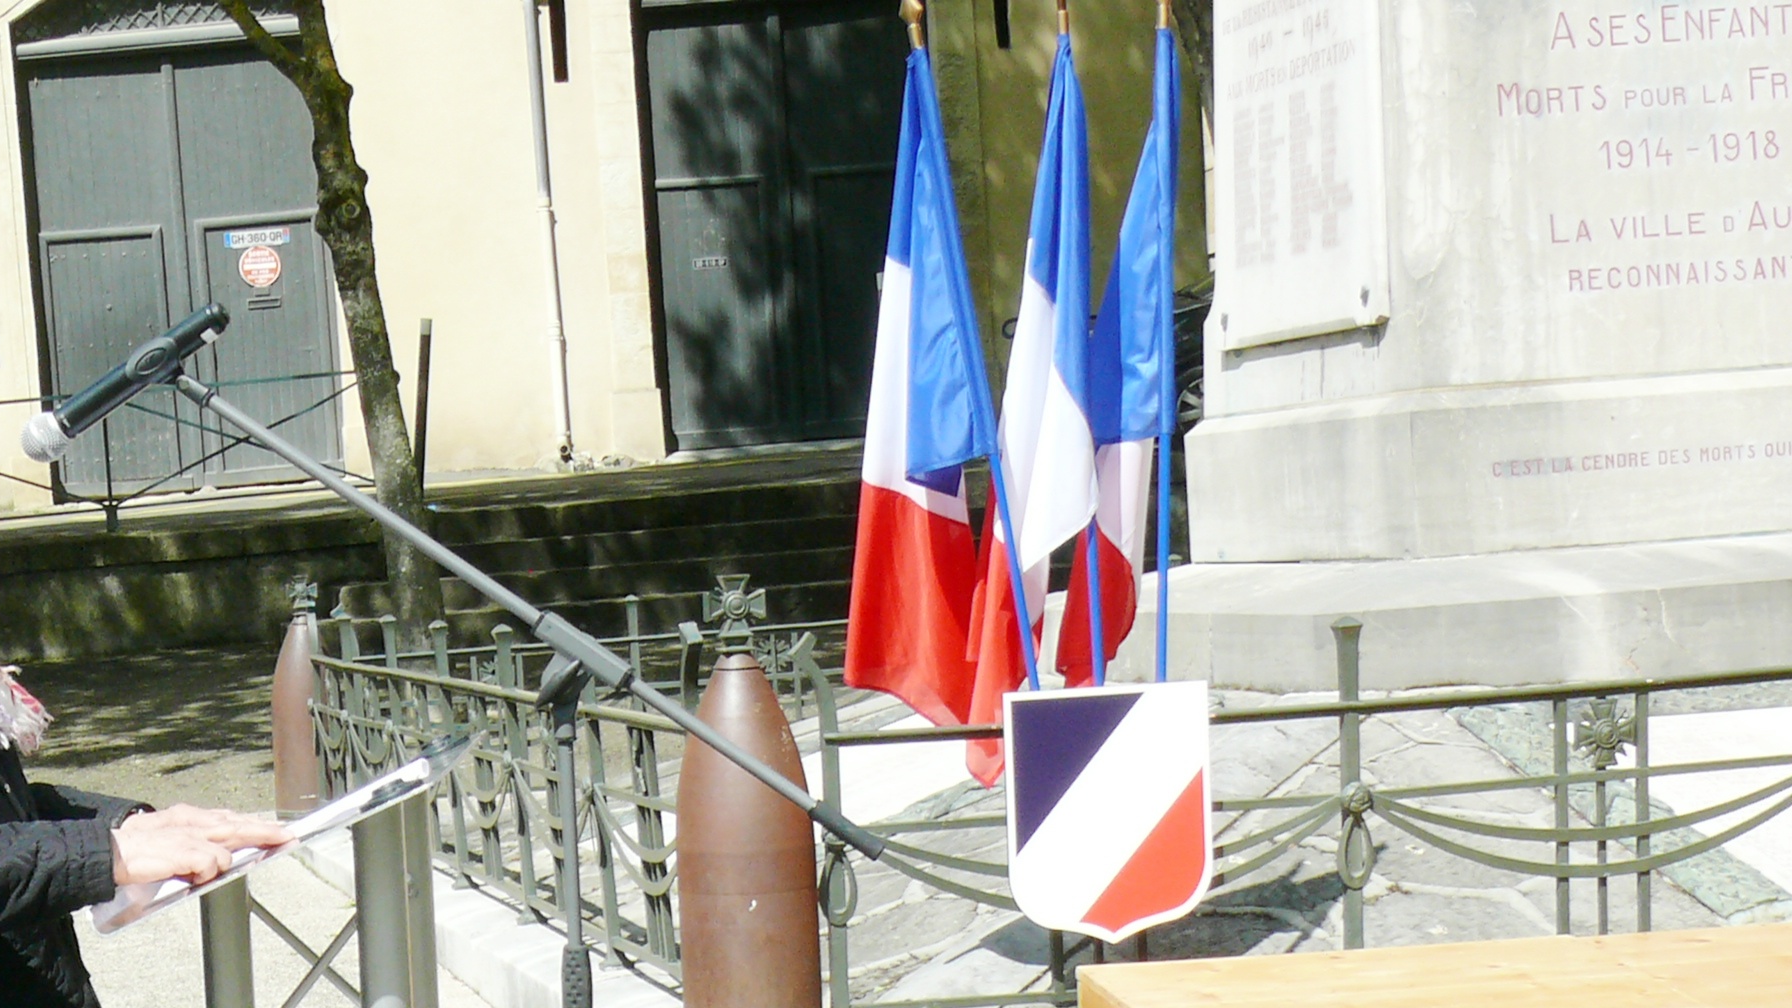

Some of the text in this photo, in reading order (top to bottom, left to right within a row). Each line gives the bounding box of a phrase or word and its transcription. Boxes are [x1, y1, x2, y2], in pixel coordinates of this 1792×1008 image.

[1550, 11, 1576, 50] A
[1587, 13, 1651, 48] SES
[1497, 82, 1607, 117] MORTS
[1624, 86, 1687, 109] POUR
[1703, 83, 1733, 104] LA
[1599, 137, 1673, 169] 1914
[1708, 130, 1779, 163] 1918
[1549, 213, 1592, 244] LA
[1610, 212, 1706, 240] VILLE
[1568, 255, 1792, 292] RECONNAISSAN
[1552, 455, 1574, 474] LA
[1582, 451, 1651, 471] CENDRE
[1659, 448, 1691, 466] DES
[1700, 443, 1756, 463] MORTS
